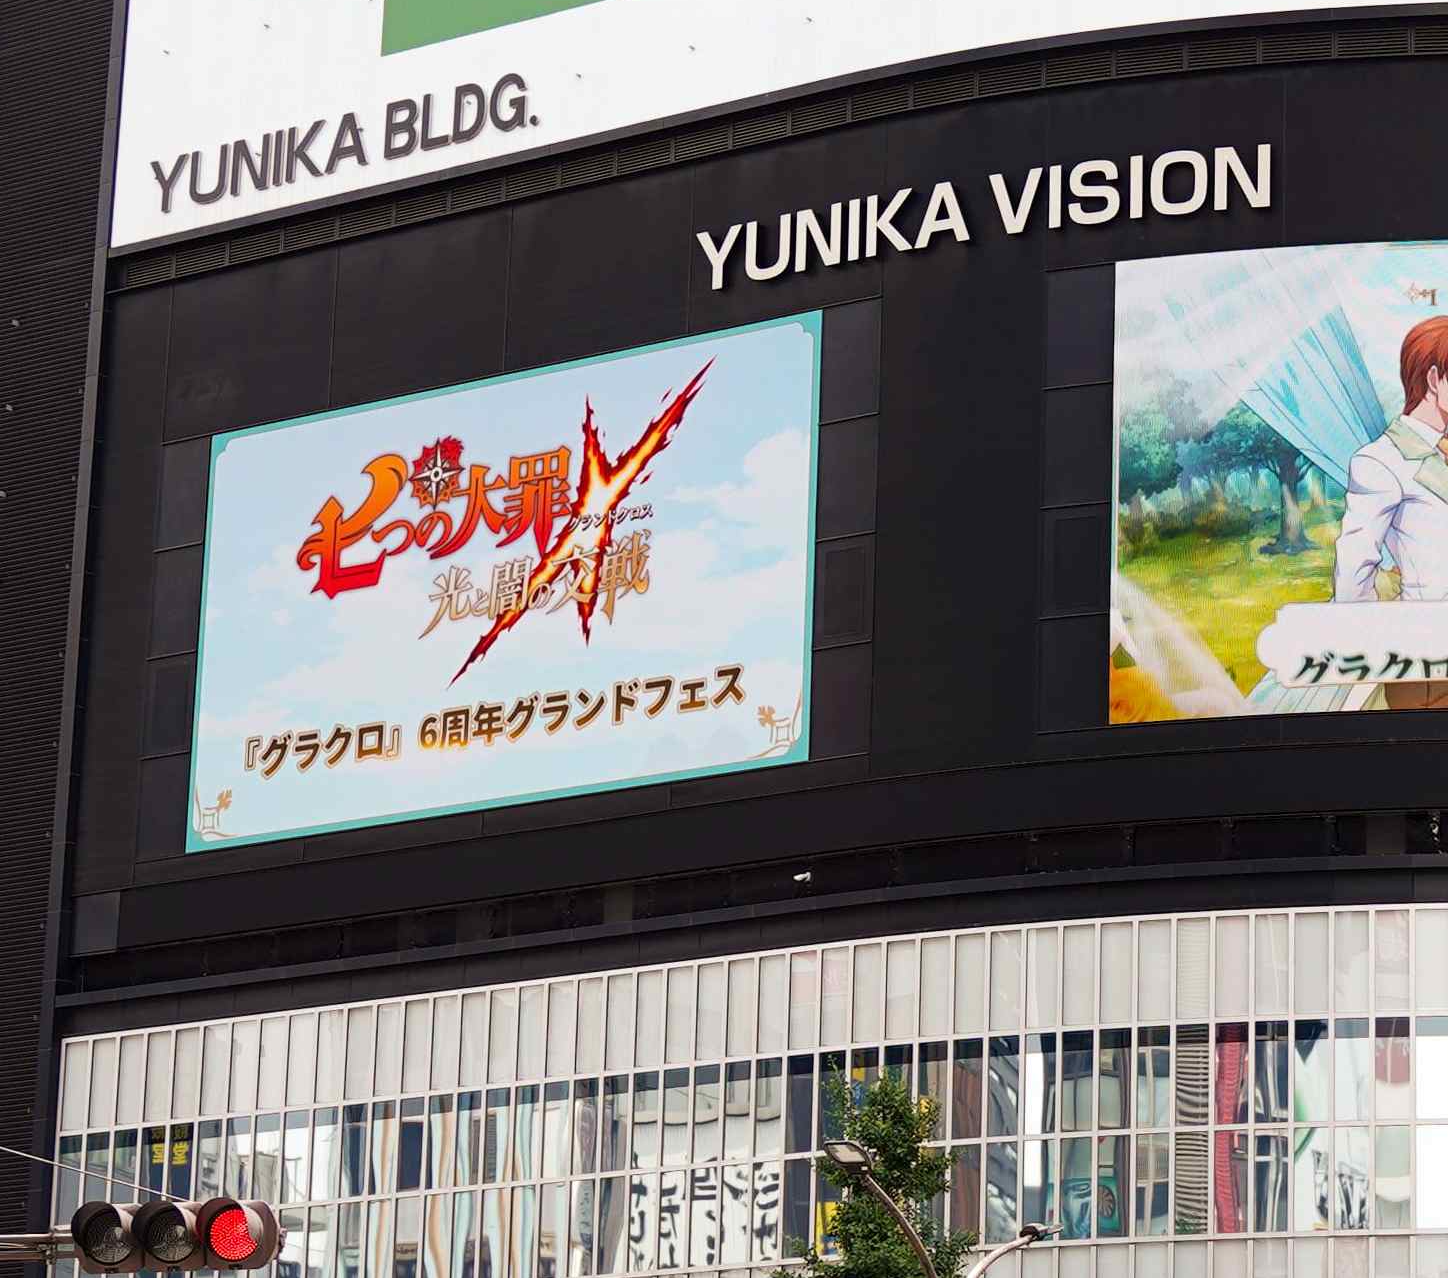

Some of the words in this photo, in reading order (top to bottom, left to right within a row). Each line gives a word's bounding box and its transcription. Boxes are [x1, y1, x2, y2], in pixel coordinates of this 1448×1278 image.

[151, 110, 368, 213] YUNIKA
[382, 71, 542, 161] BLDG.
[697, 178, 964, 291] YUNIKA
[996, 143, 1271, 238] VISION
[297, 445, 574, 599] 七つの大罪
[418, 528, 652, 641] 光と闇の交戦
